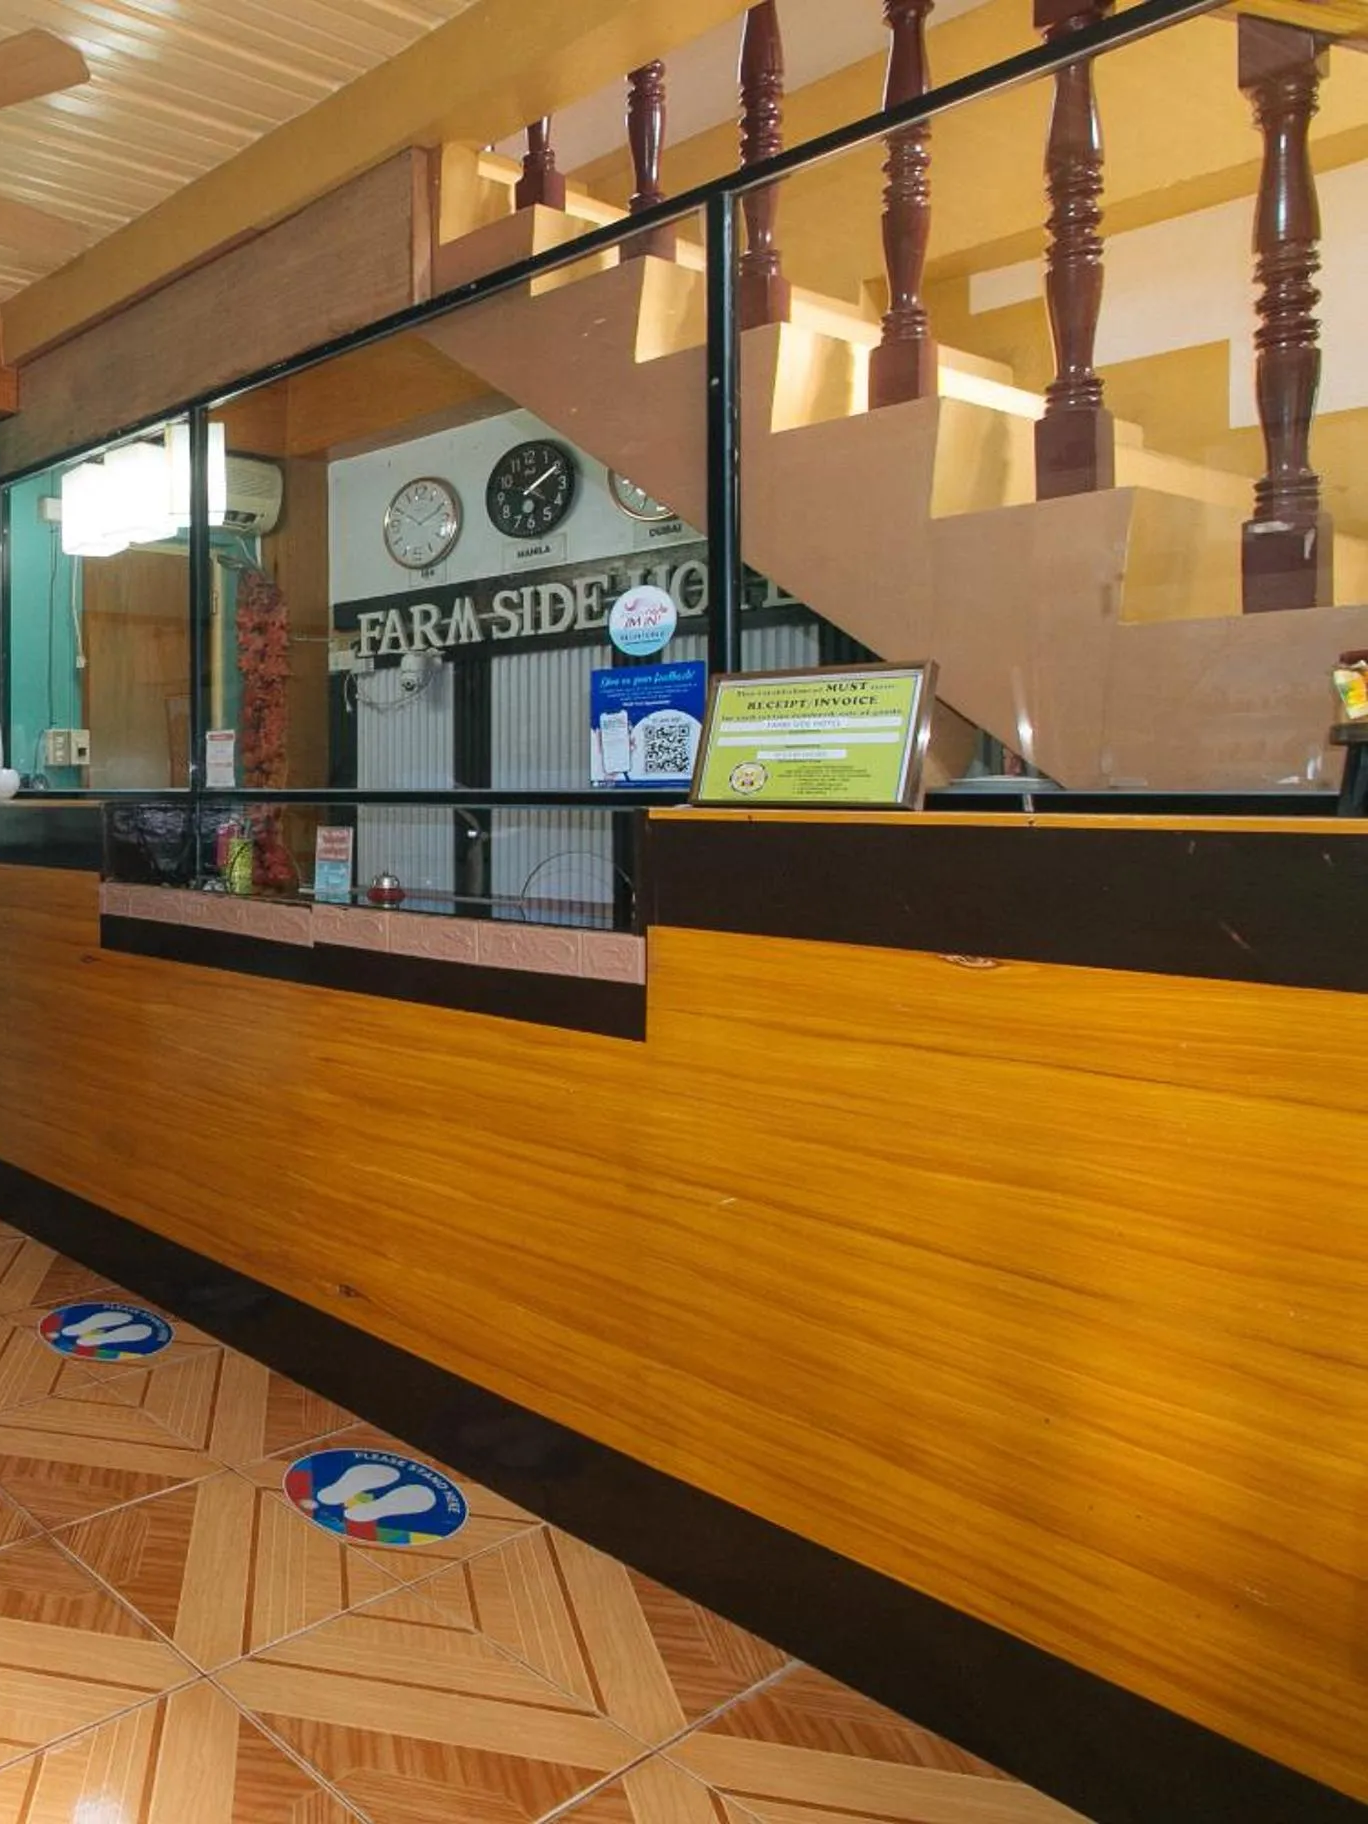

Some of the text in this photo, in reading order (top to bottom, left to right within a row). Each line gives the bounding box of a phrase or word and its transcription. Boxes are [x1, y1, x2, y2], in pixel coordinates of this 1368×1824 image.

[357, 597, 483, 658] FARM
[492, 574, 609, 640] SIDE
[825, 681, 868, 692] MUST
[354, 1453, 406, 1467] PLEASE
